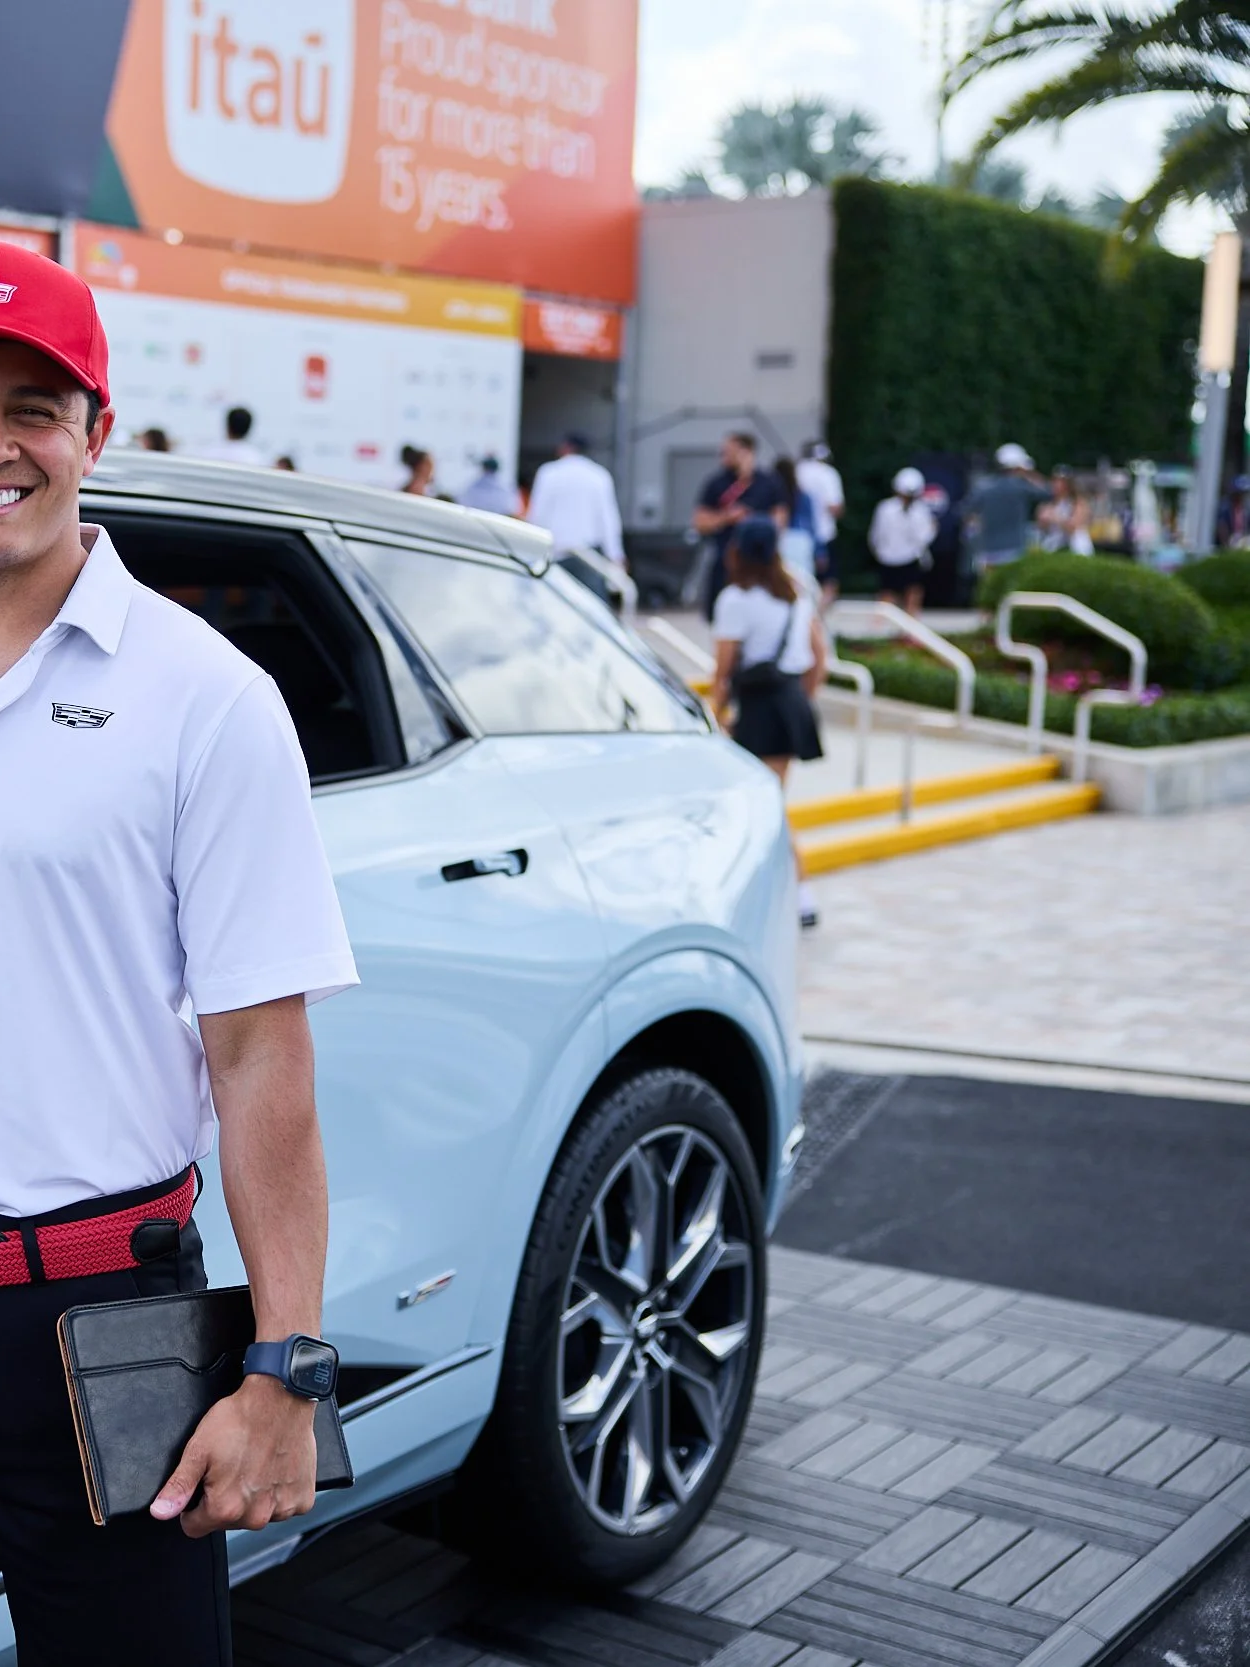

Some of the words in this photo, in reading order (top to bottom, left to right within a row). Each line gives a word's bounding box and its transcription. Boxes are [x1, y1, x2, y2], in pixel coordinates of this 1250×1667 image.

[190, 0, 330, 136] itaú
[381, 3, 486, 87] Proud
[488, 42, 608, 117] sponsor
[377, 147, 418, 214] 15
[379, 68, 429, 141] for
[433, 100, 521, 166] more
[523, 110, 598, 182] than
